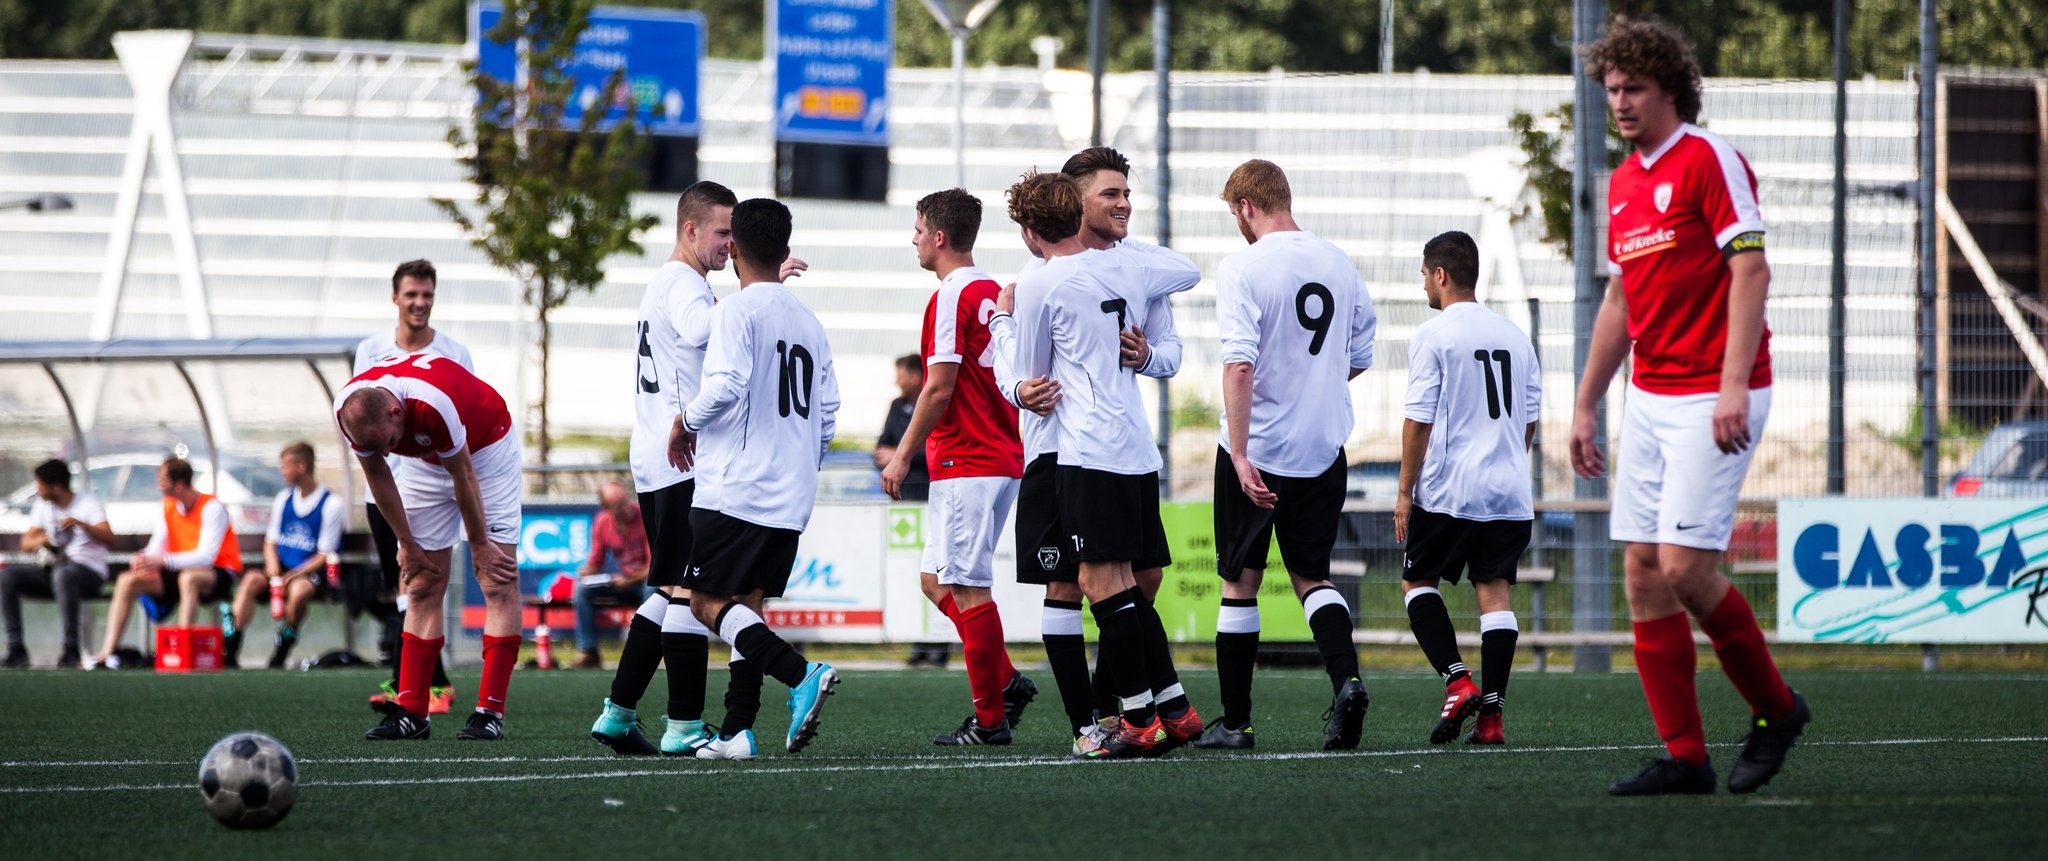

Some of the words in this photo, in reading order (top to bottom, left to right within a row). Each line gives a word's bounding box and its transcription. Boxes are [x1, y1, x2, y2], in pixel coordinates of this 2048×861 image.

[1100, 298, 1127, 373] 7
[1295, 282, 1335, 356] 9
[777, 340, 814, 420] 10
[1474, 349, 1512, 420] 11
[1793, 523, 2028, 590] CASBA
